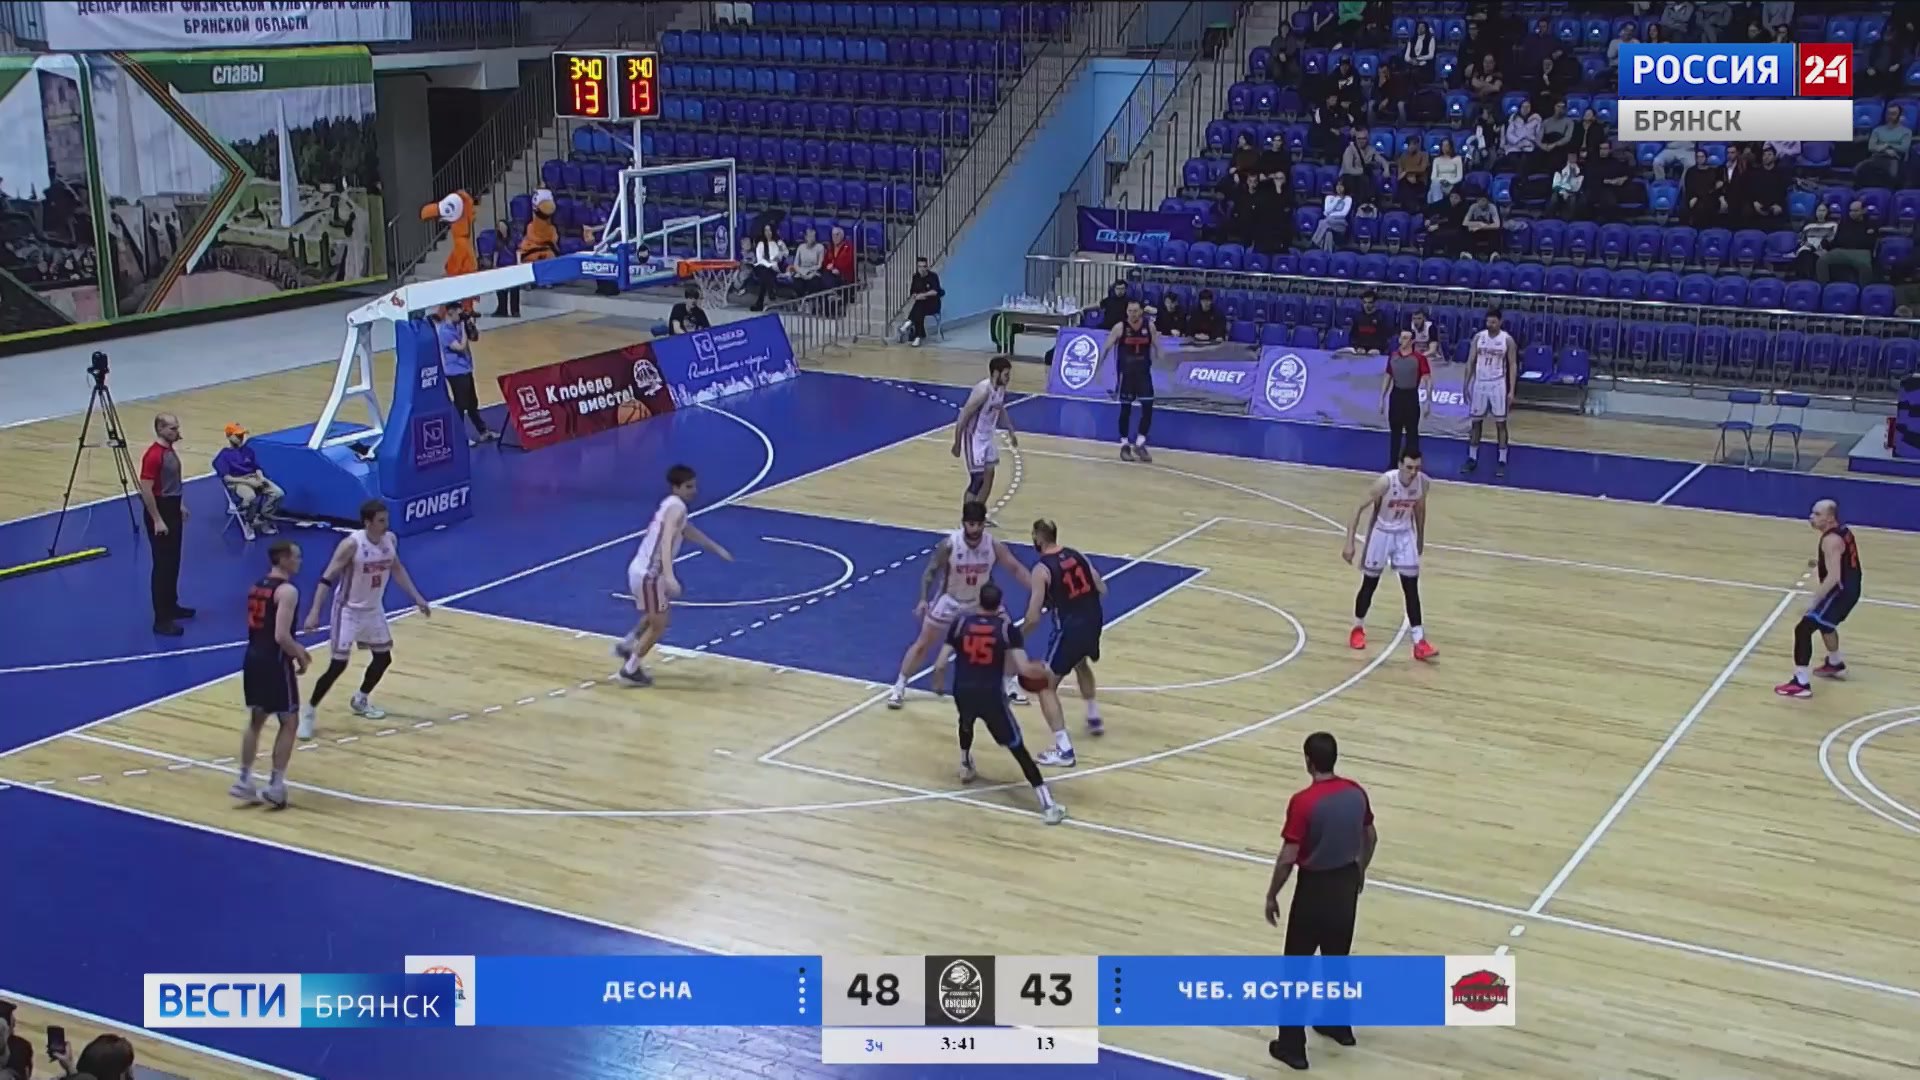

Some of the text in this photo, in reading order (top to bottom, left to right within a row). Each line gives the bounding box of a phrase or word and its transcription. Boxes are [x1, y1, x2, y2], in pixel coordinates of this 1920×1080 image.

[184, 15, 308, 33] БРЯНСКОЙ ОБЛАСТИ
[575, 80, 599, 114] 13
[631, 79, 650, 113] 13
[545, 375, 613, 404] К победе
[1189, 367, 1246, 384] FONBET
[578, 384, 635, 415] вместе!
[406, 488, 470, 521] FONBET
[1063, 566, 1092, 599] 11
[963, 635, 997, 665] 45
